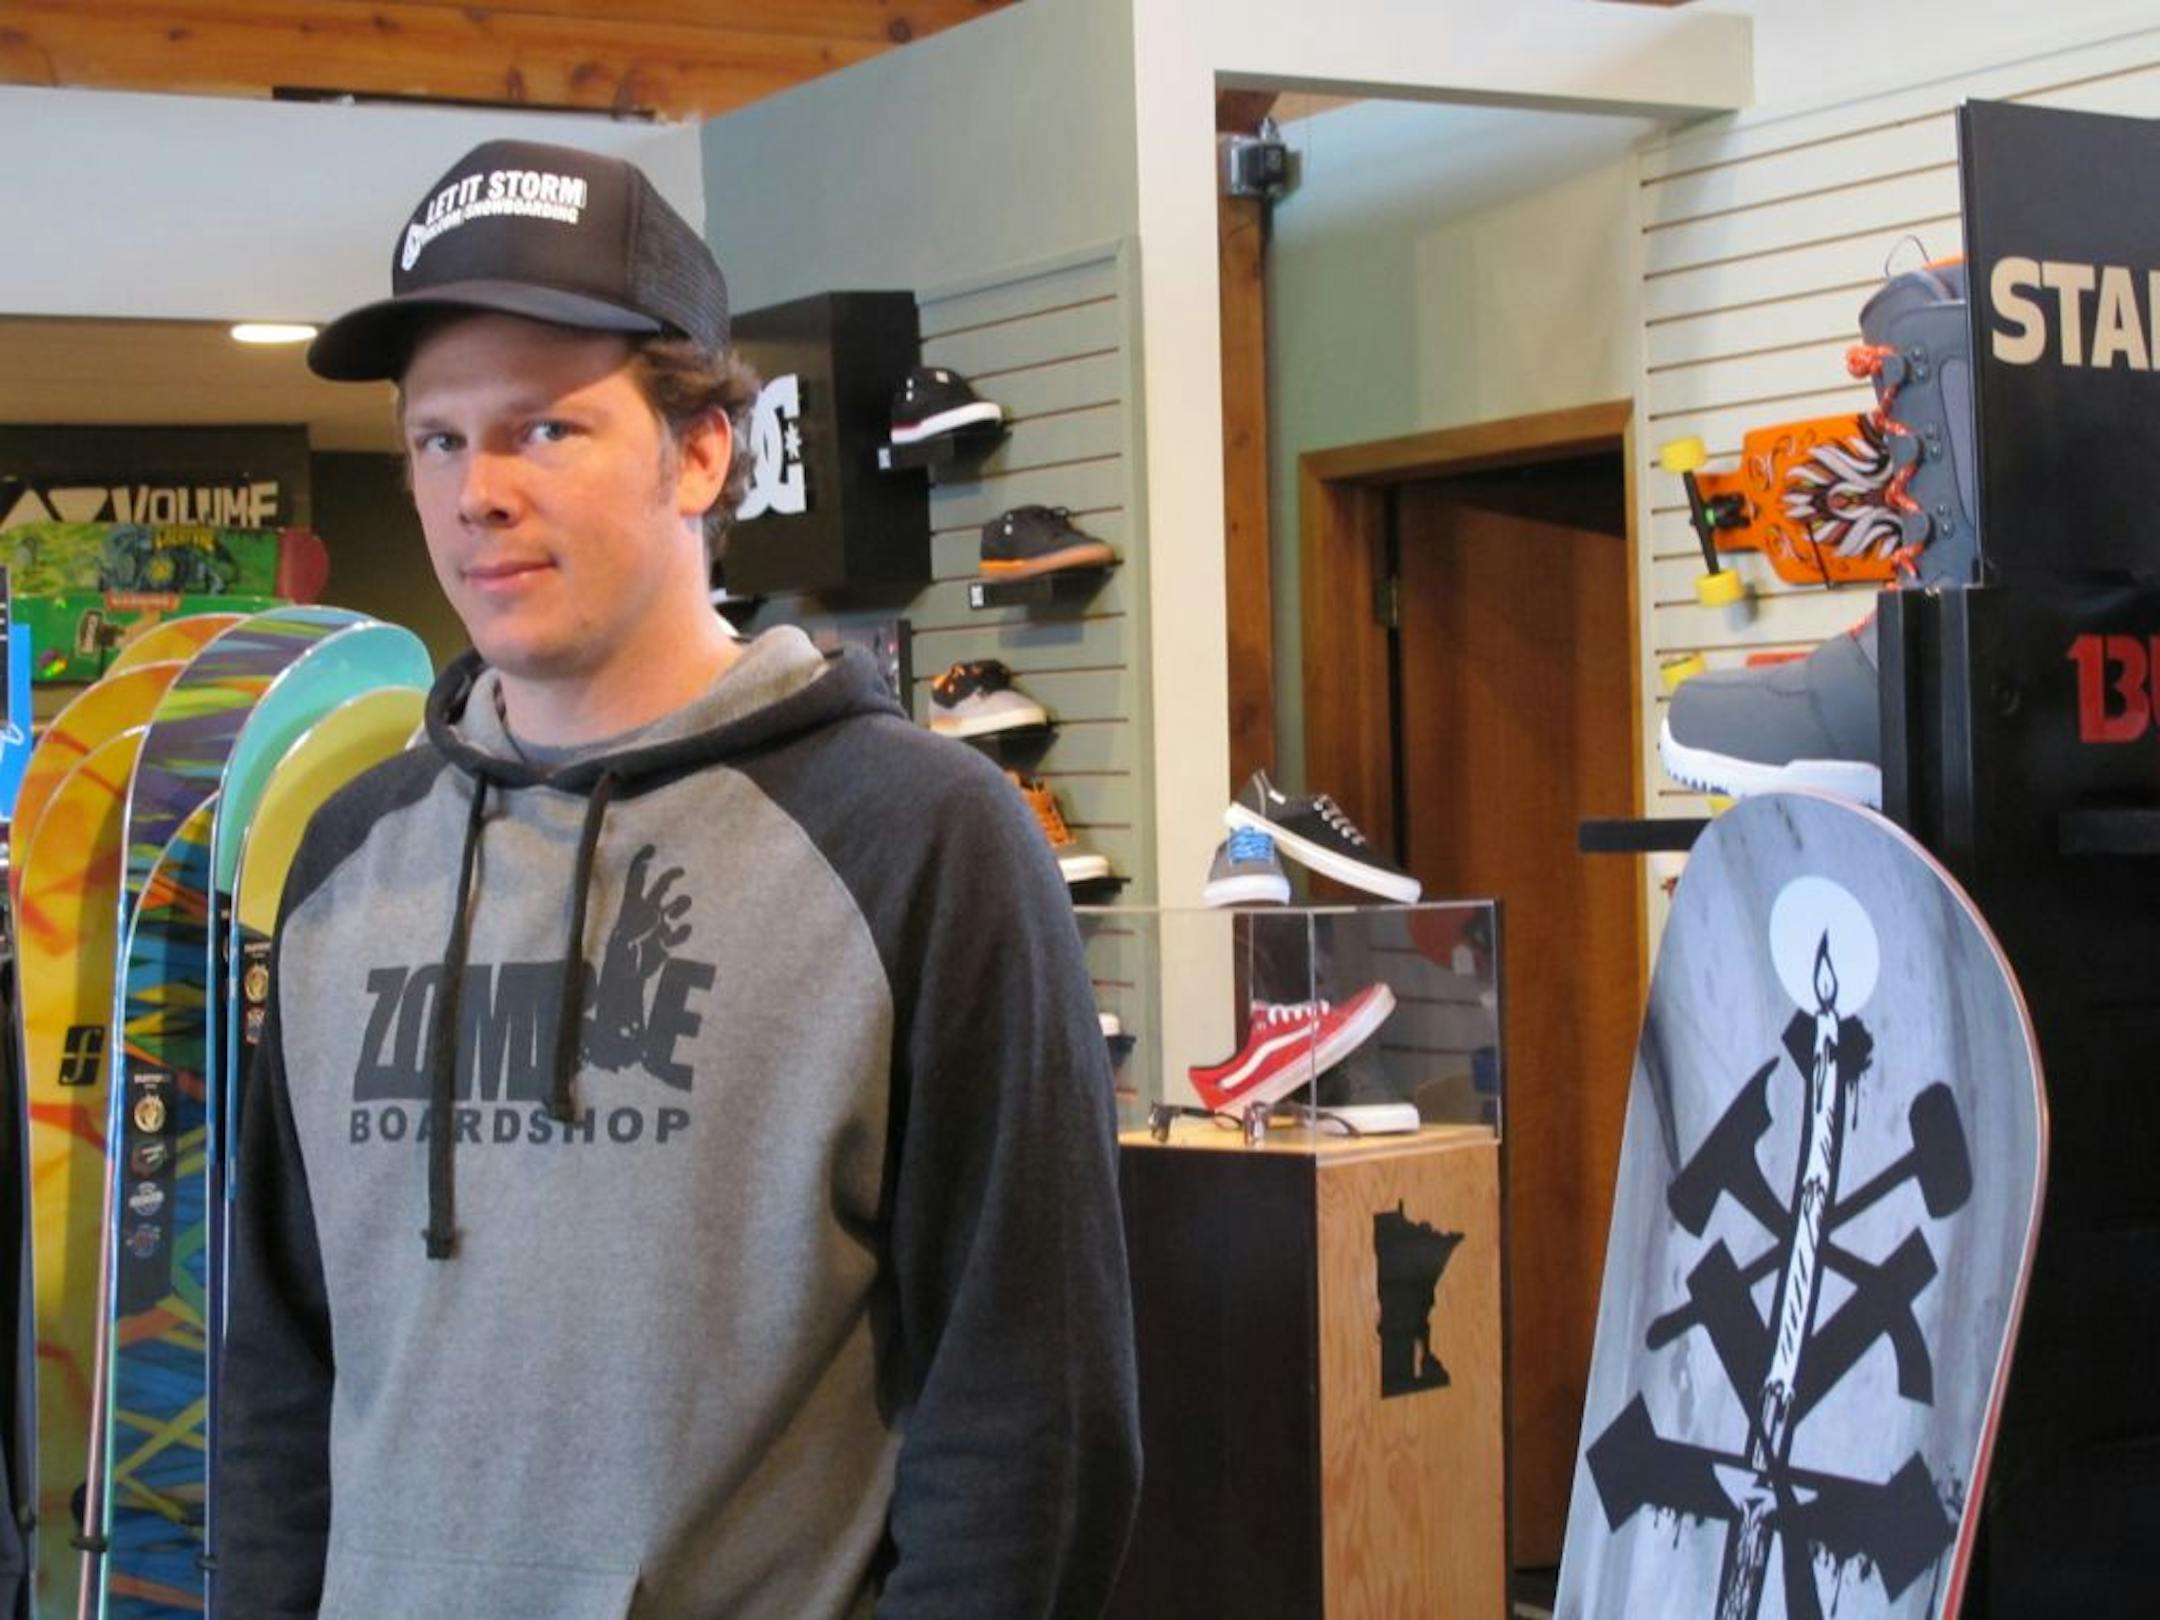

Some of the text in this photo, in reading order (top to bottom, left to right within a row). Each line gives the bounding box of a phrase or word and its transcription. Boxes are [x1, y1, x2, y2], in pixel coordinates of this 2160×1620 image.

[426, 170, 586, 225] LET IT STORM
[1990, 256, 2160, 372] STA
[2066, 632, 2160, 744] B
[350, 1105, 691, 1145] BOARDSHOP
